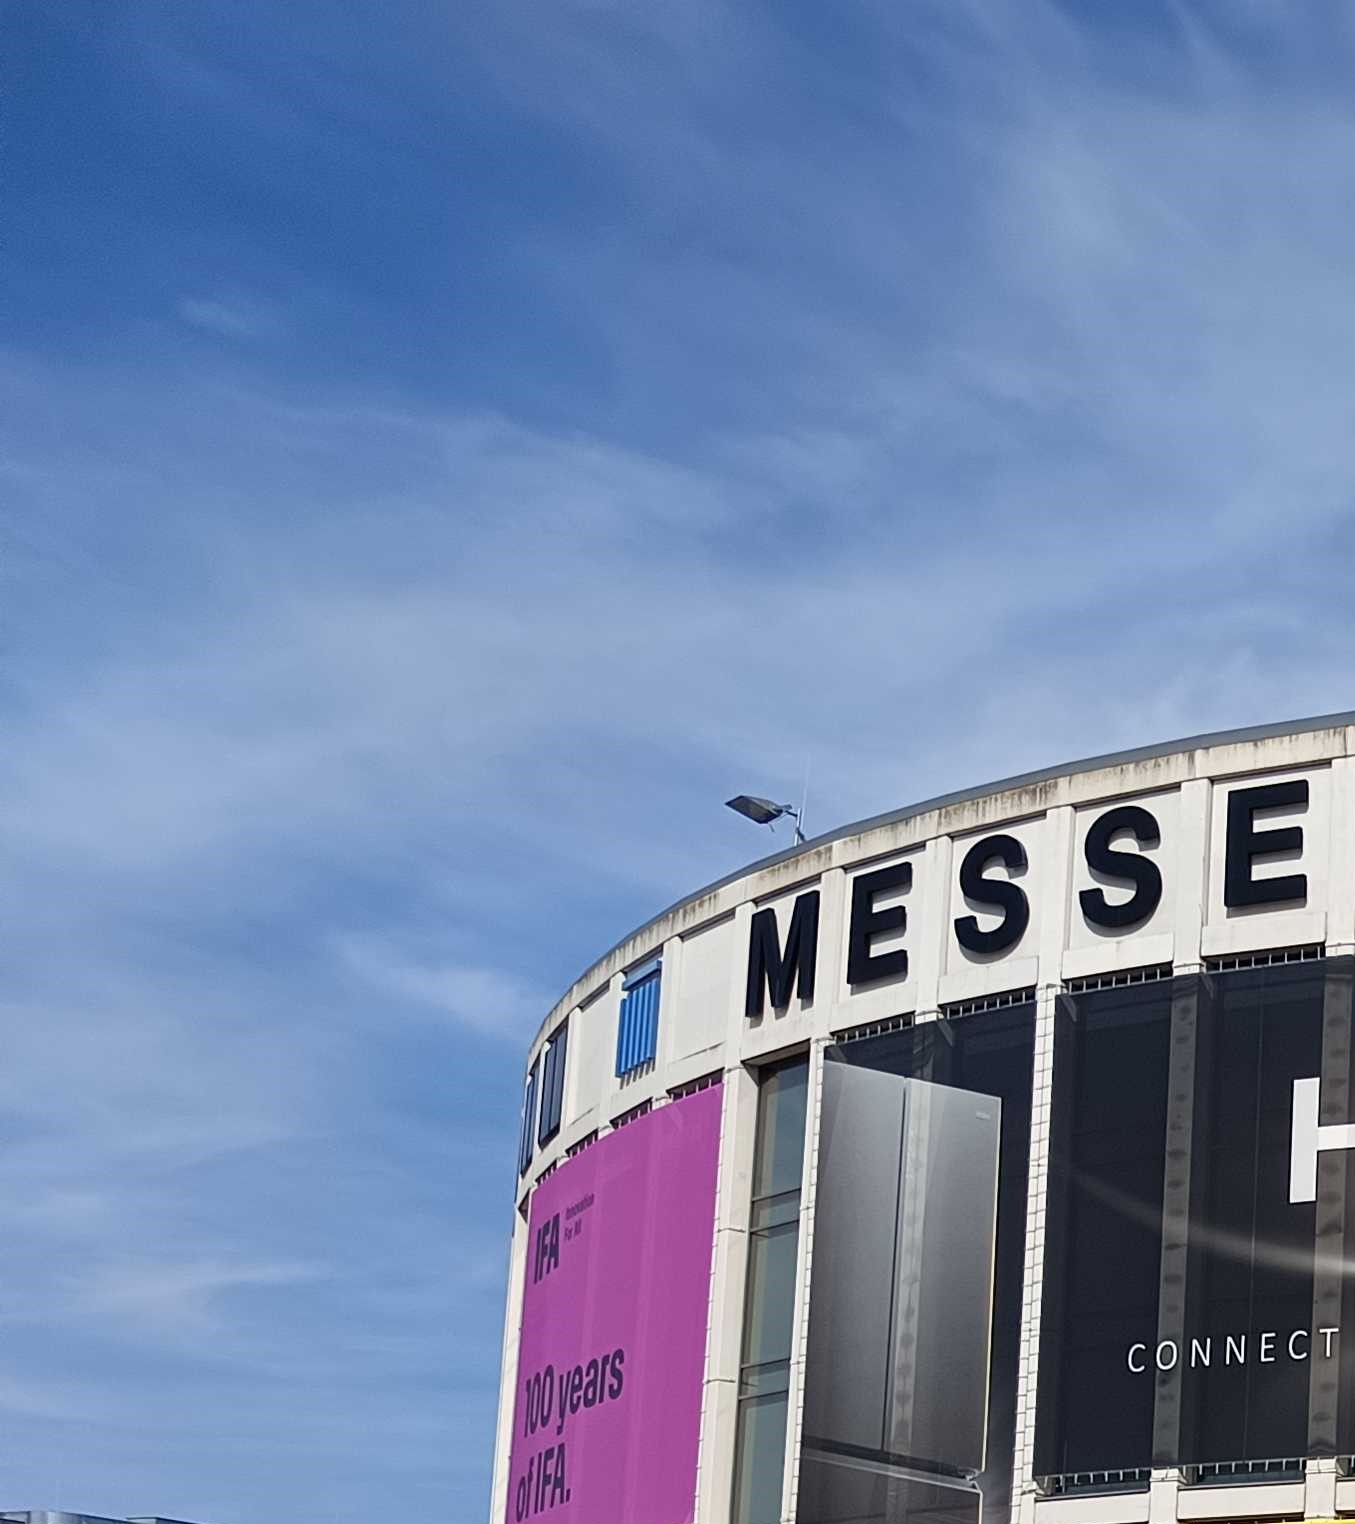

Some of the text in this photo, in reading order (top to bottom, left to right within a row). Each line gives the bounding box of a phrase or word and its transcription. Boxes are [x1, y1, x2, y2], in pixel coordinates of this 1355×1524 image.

[745, 778, 1309, 1018] MESSE
[533, 1212, 560, 1285] IFA
[1127, 1327, 1341, 1373] CONNECT
[524, 1348, 625, 1438] 100 years
[515, 1442, 571, 1523] of IFA.
